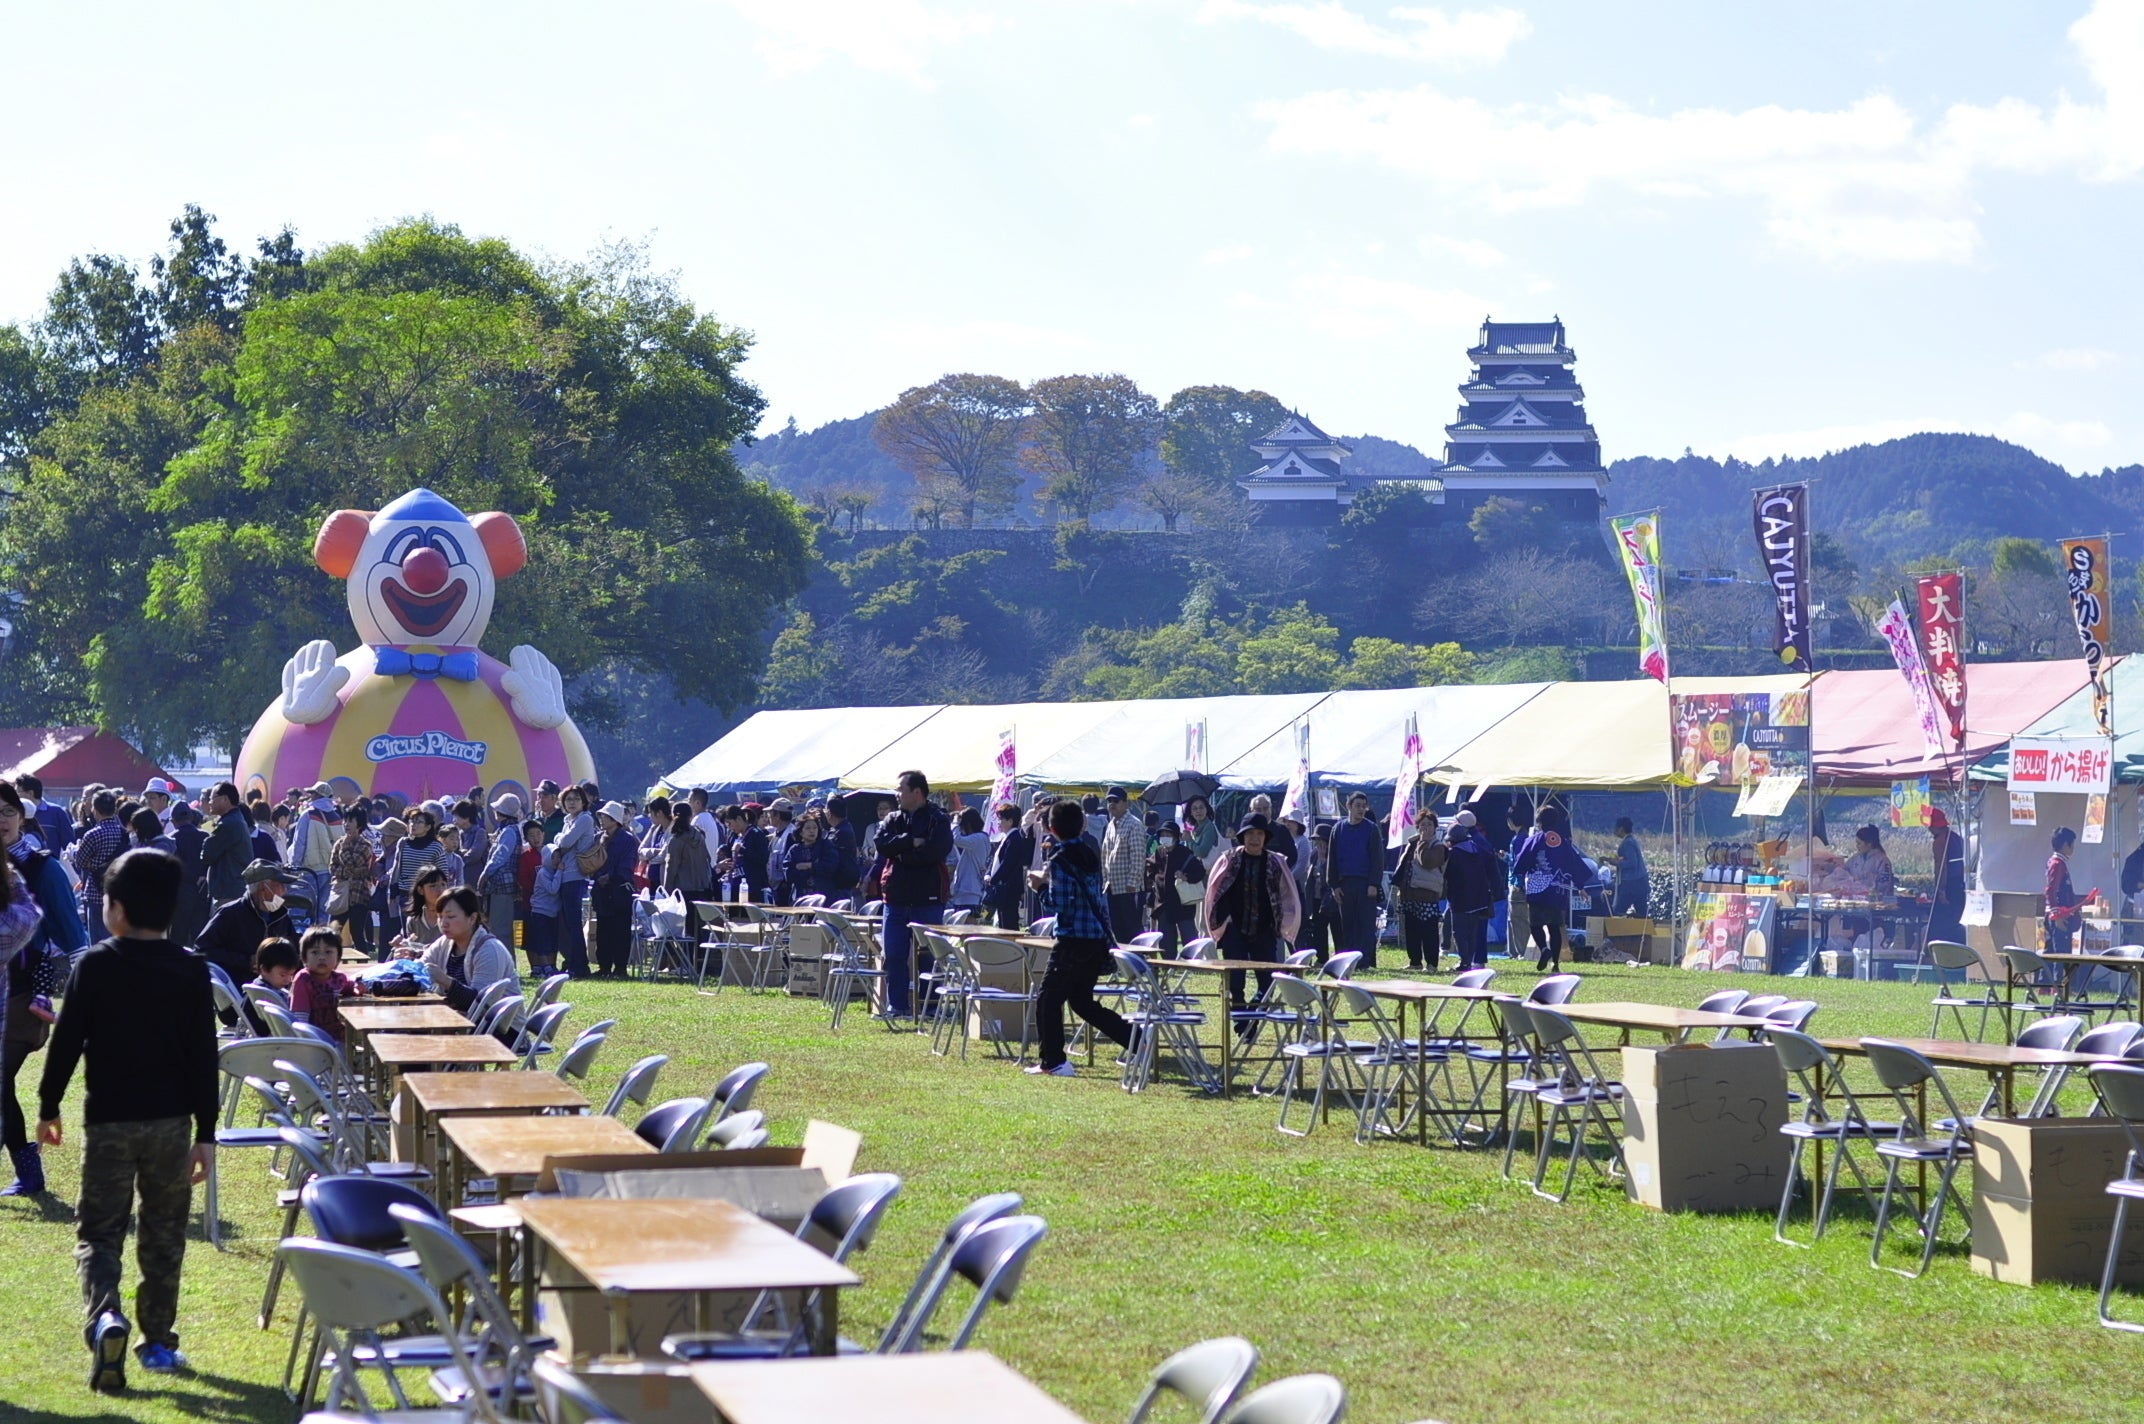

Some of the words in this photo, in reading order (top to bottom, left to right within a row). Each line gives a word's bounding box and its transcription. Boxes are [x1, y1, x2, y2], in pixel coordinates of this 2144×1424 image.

[1925, 585, 1964, 707] 大判焼
[1678, 702, 1730, 721] スムージー
[366, 738, 427, 760] Circus
[426, 732, 485, 763] Pierrot
[1753, 729, 1778, 743] CAJYUTTA
[2050, 749, 2109, 783] から揚げ
